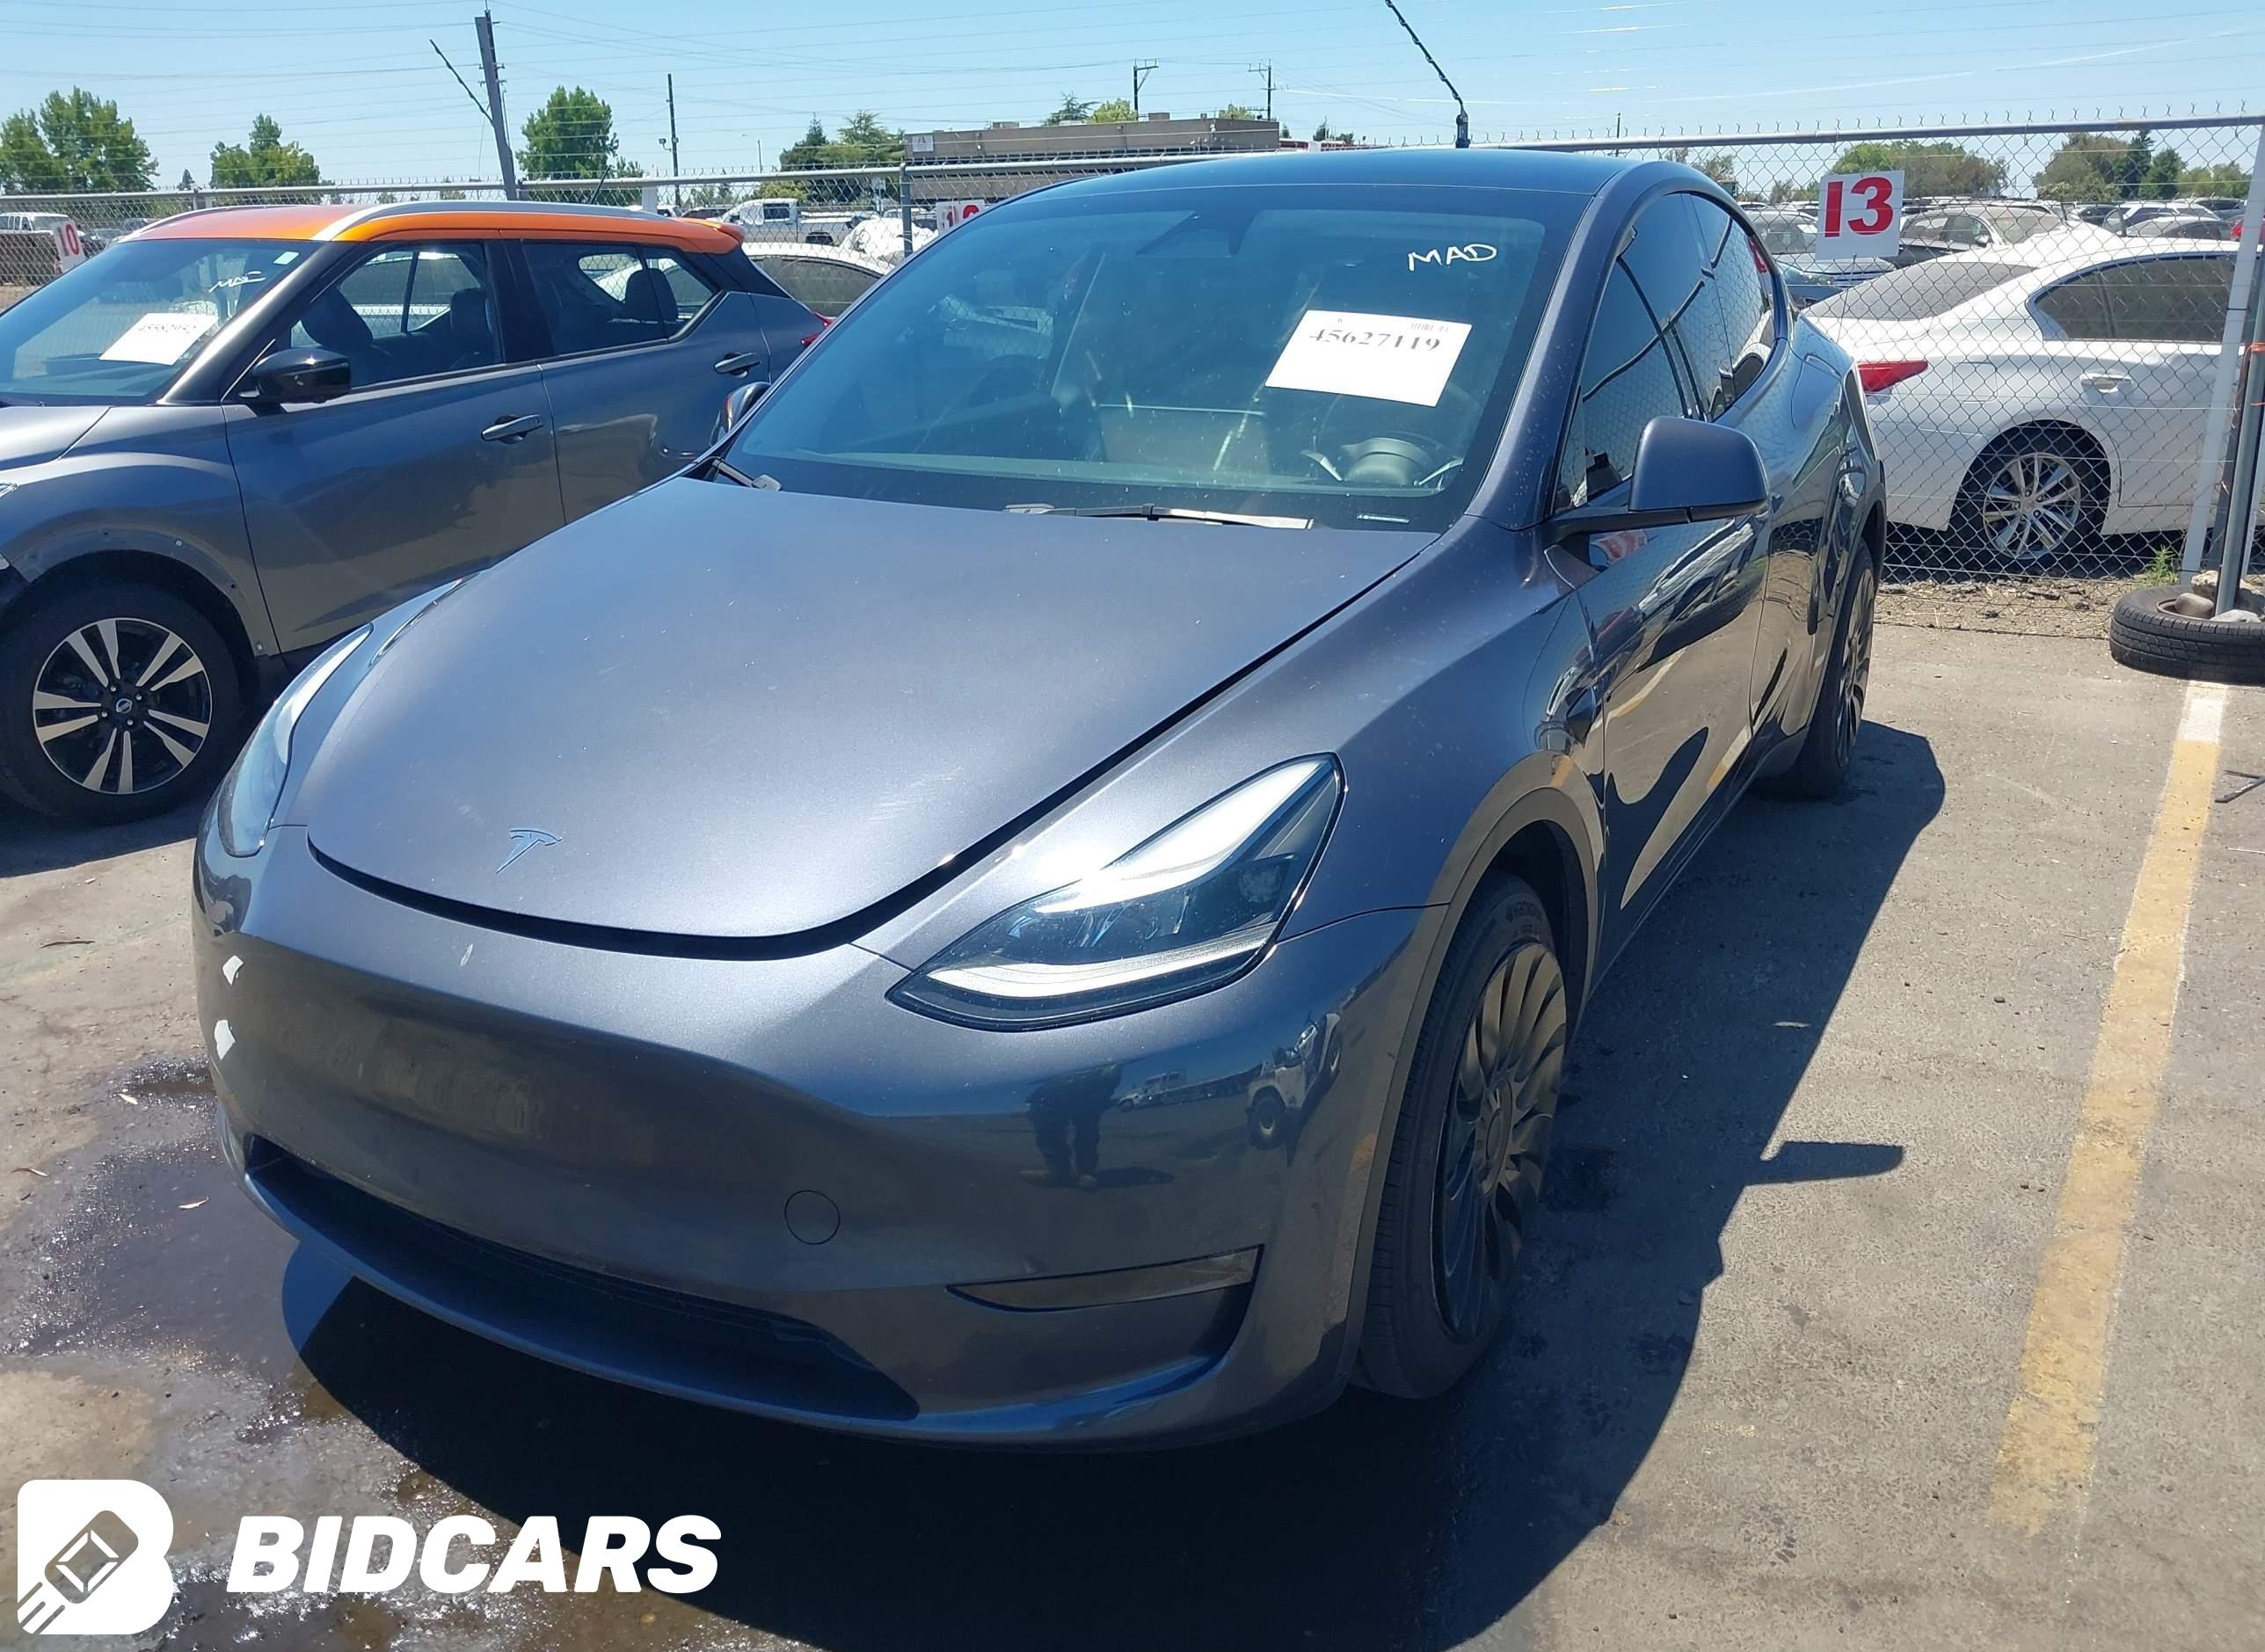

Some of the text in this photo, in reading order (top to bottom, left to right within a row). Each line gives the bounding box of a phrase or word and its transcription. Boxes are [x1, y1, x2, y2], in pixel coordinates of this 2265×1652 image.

[1824, 177, 1894, 237] 13
[57, 223, 80, 256] 10
[1408, 244, 1497, 272] MAD
[1309, 329, 1440, 351] 45627119
